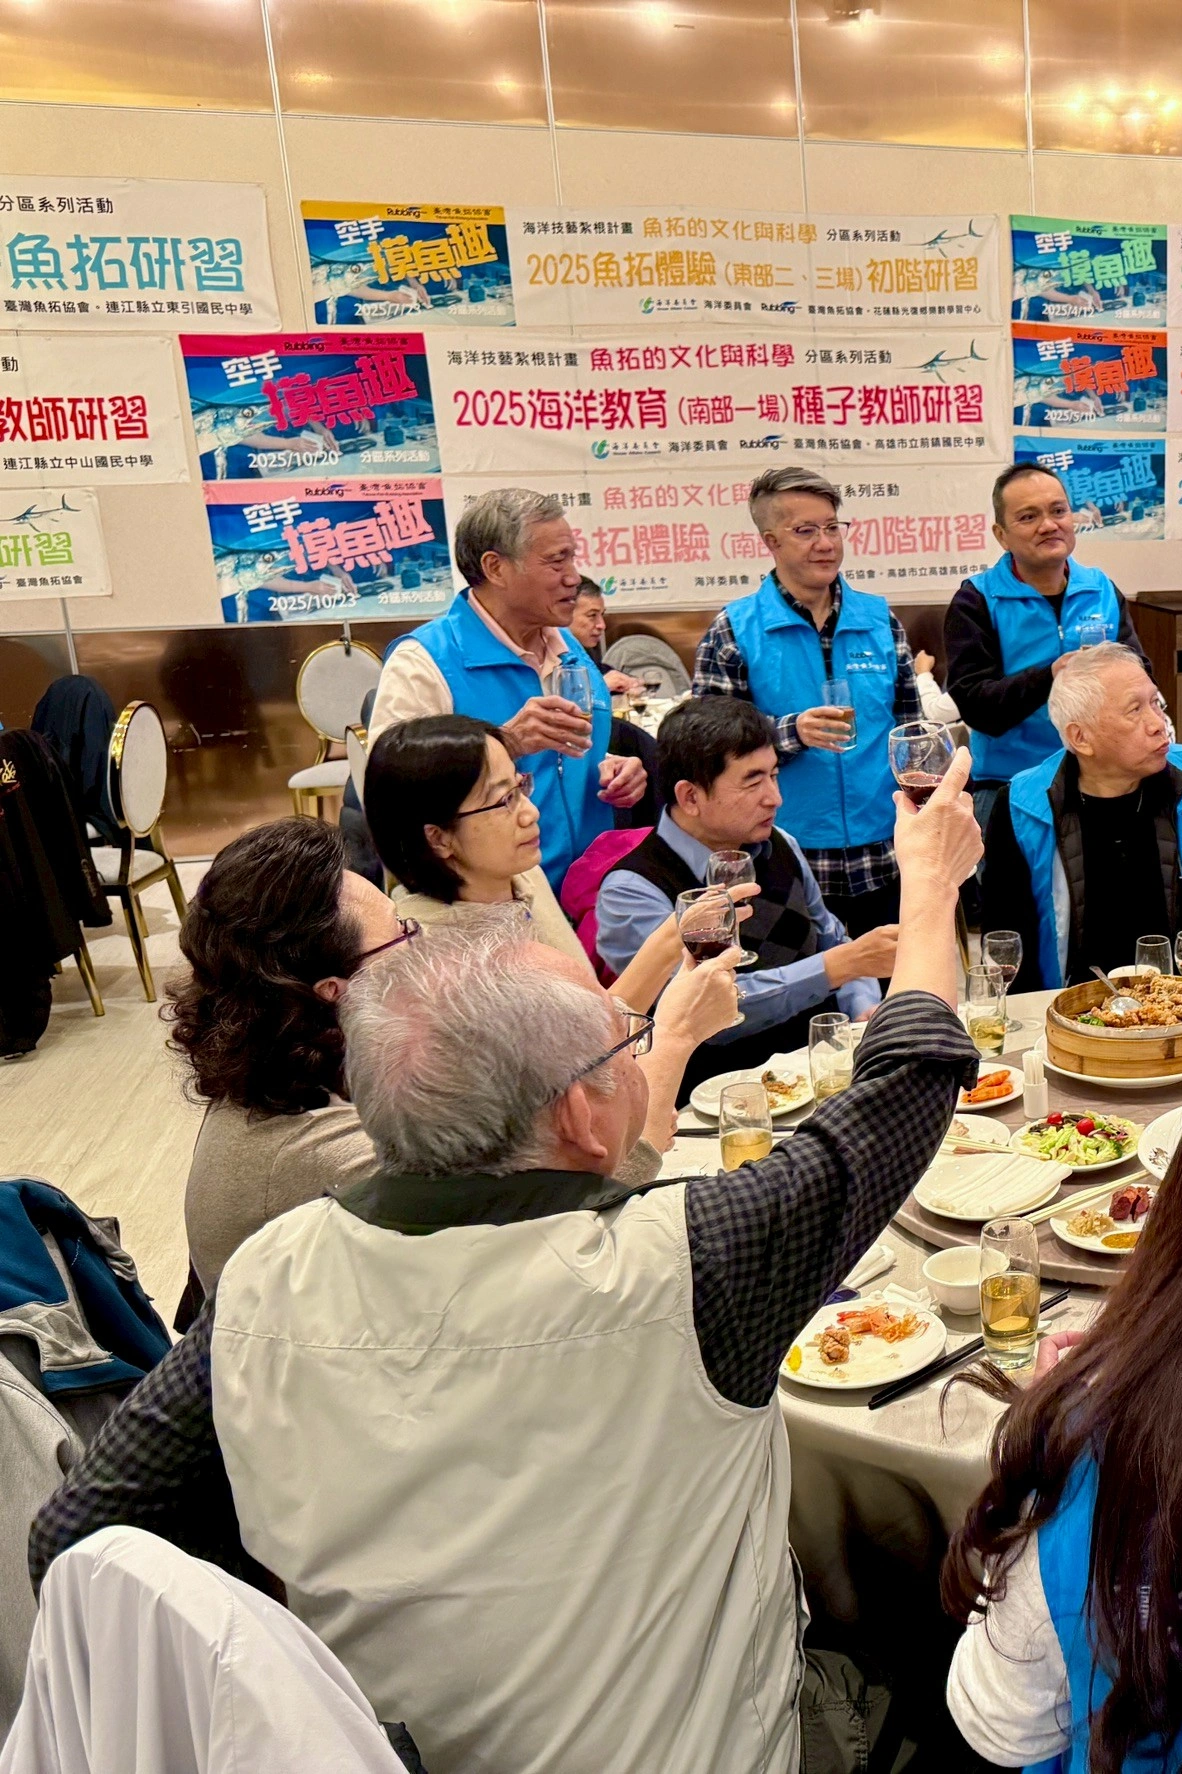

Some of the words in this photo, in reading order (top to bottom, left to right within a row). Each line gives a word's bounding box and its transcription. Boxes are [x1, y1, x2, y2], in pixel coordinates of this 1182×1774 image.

[0, 195, 114, 214] 分區系列活動
[334, 216, 385, 246] 空手
[643, 217, 817, 244] 魚拓的文化與科學
[827, 228, 901, 243] 分區系列活動
[1034, 230, 1073, 254] 空手
[6, 232, 245, 293] 魚拓研習
[367, 222, 498, 285] 摸魚趣
[1058, 239, 1157, 290] 摸魚趣
[704, 300, 752, 311] 海洋委員會
[761, 302, 796, 314] Rubbing
[591, 344, 794, 371] 魚拓的文化與科學
[806, 349, 892, 364] 分區系列活動
[1036, 337, 1074, 361] 空手
[2, 356, 18, 372] 動
[222, 350, 282, 388] 空手
[261, 352, 417, 431] 摸魚趣
[0, 395, 149, 443] 教師研習
[668, 440, 728, 453] 海洋委員會
[739, 438, 780, 450] Rubbing
[4, 455, 154, 470] 連江縣立中山國民中學
[248, 451, 339, 469] 2025/10/20
[305, 485, 346, 498] Rubbing
[243, 497, 302, 533] 空手
[282, 500, 435, 574] 摸魚趣
[849, 514, 986, 556] 初階研習
[16, 575, 83, 587] 臺灣魚拓協會
[695, 575, 749, 587] 海洋委員會
[268, 593, 357, 612] 2025/10/23
